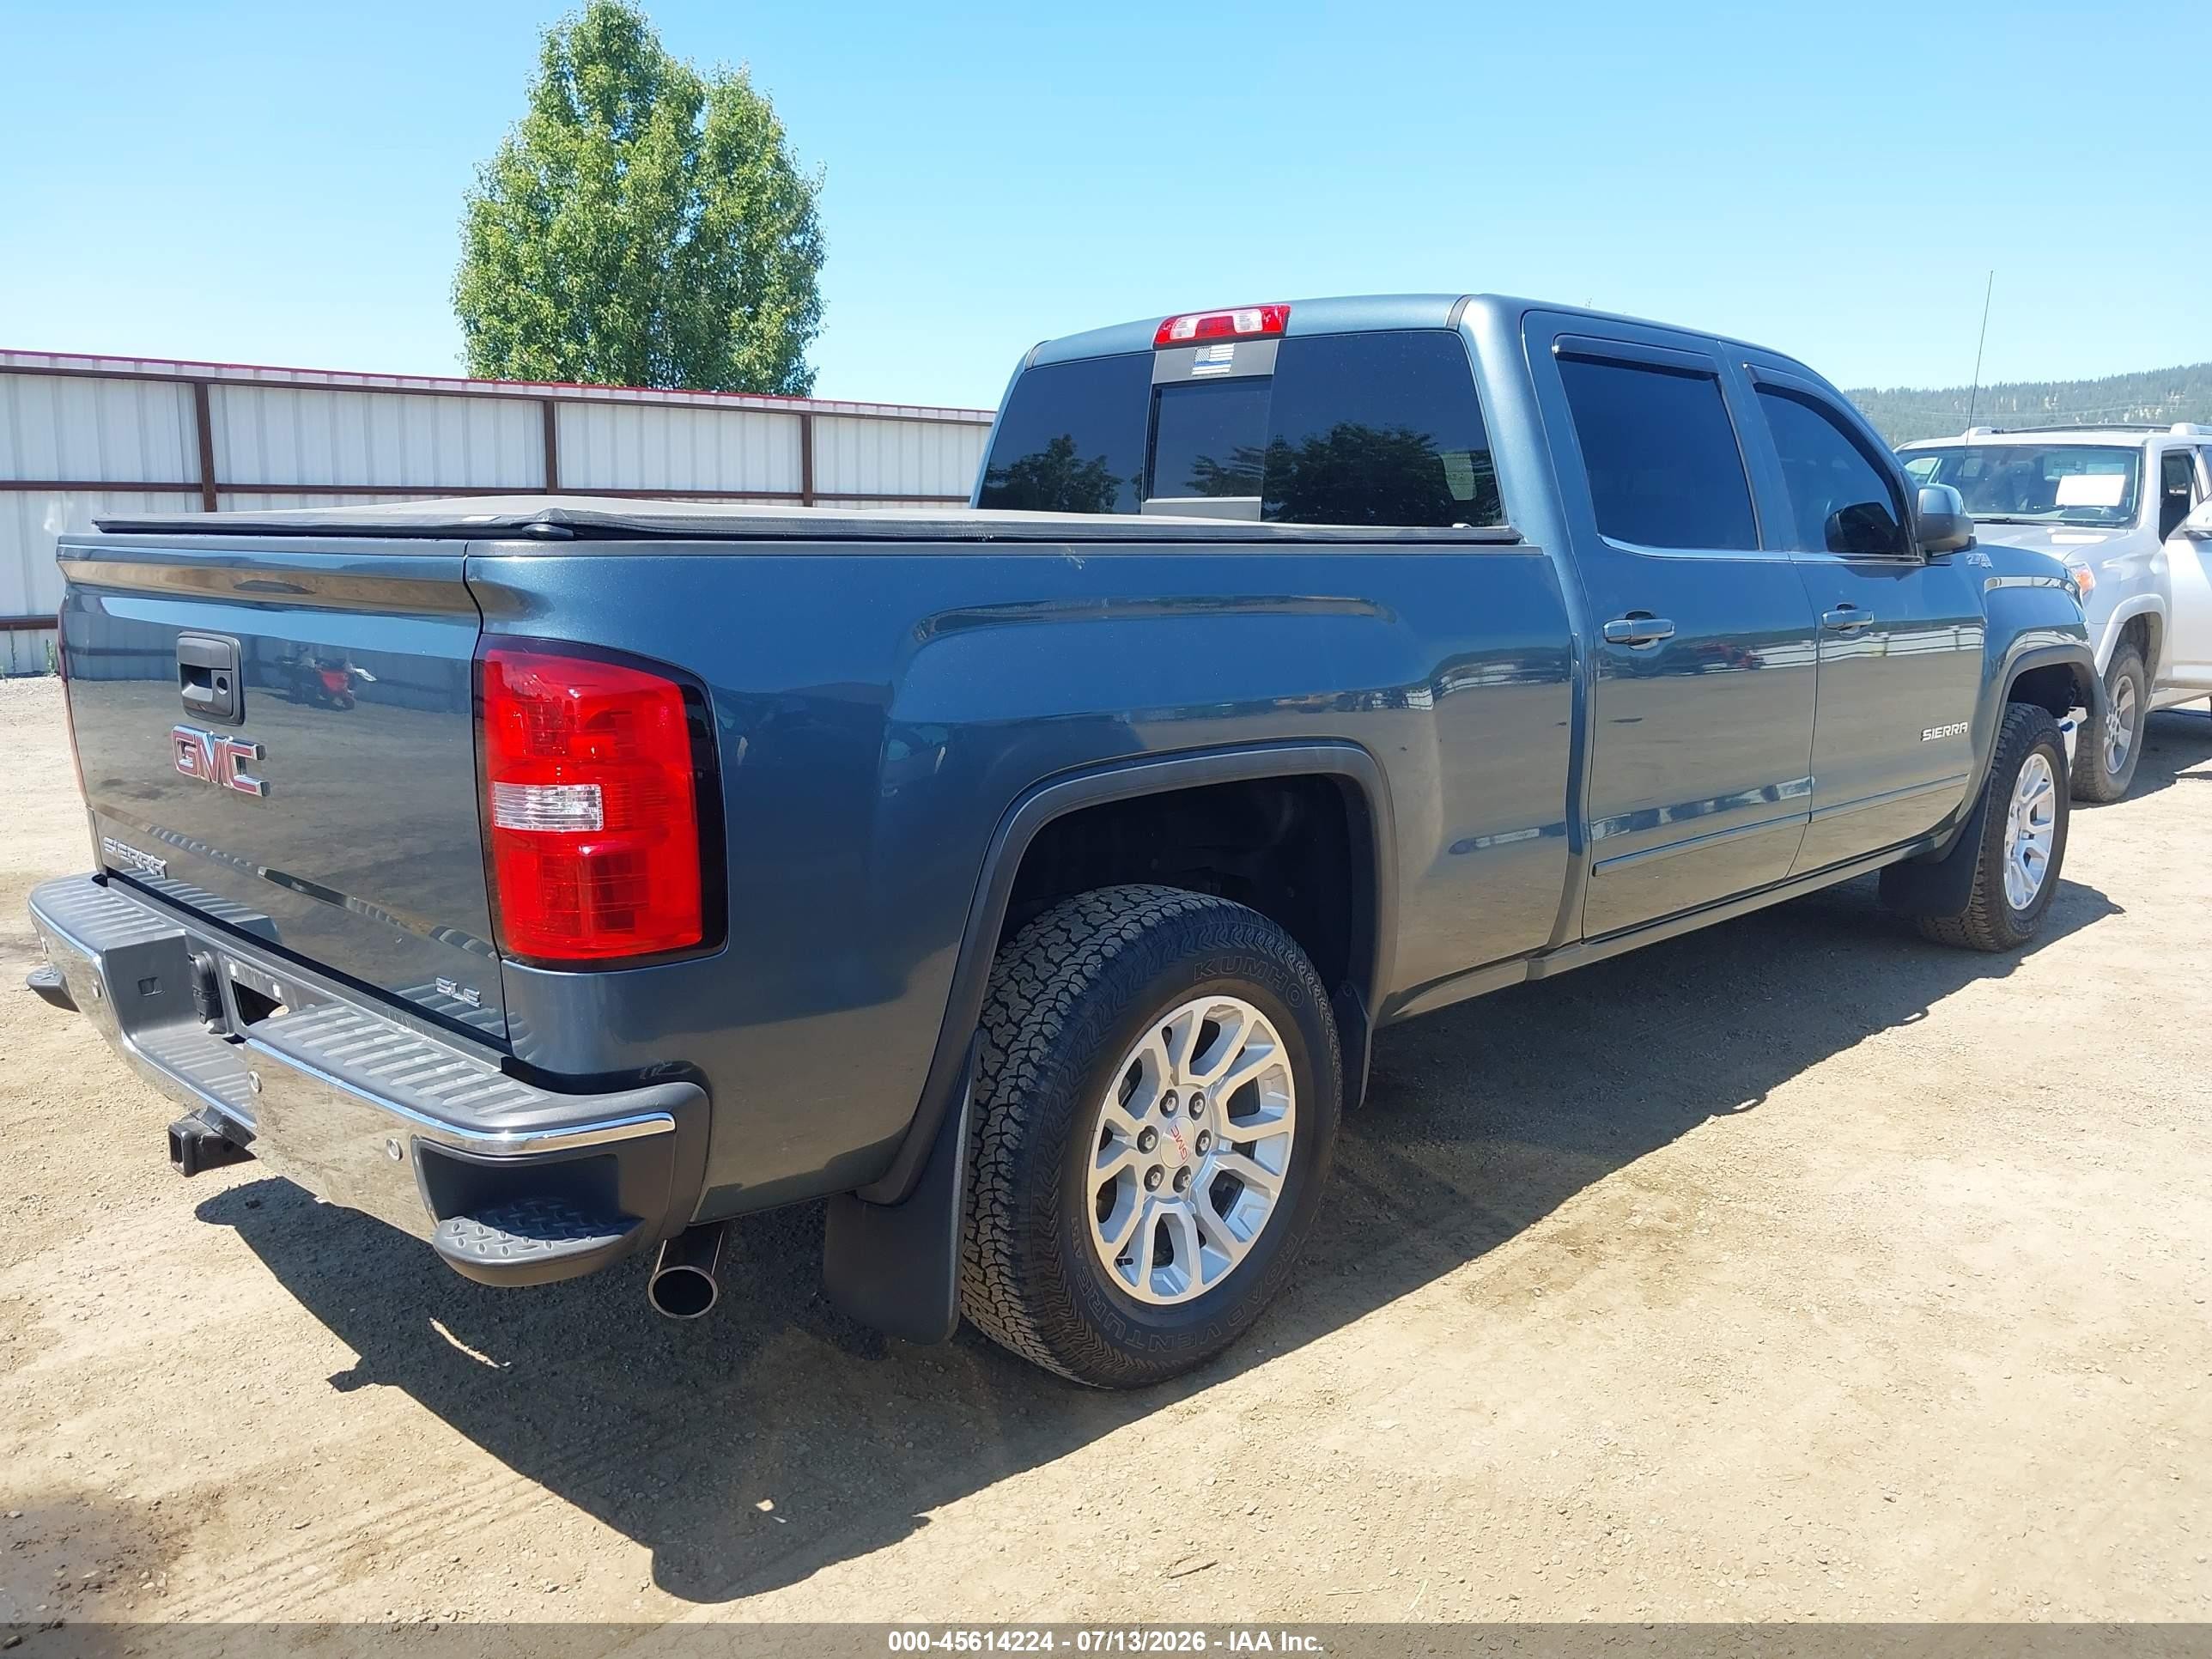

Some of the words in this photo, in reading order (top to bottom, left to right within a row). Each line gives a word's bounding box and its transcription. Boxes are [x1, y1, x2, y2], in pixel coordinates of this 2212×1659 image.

[1920, 721, 1969, 742] SIERRA
[171, 724, 270, 798] GMC
[103, 836, 167, 880] SIERRA
[1194, 956, 1305, 1009] KUMHO
[1170, 1123, 1188, 1161] GMC
[1226, 1232, 1300, 1328] ROAD
[1076, 1267, 1223, 1353] VENTURE
